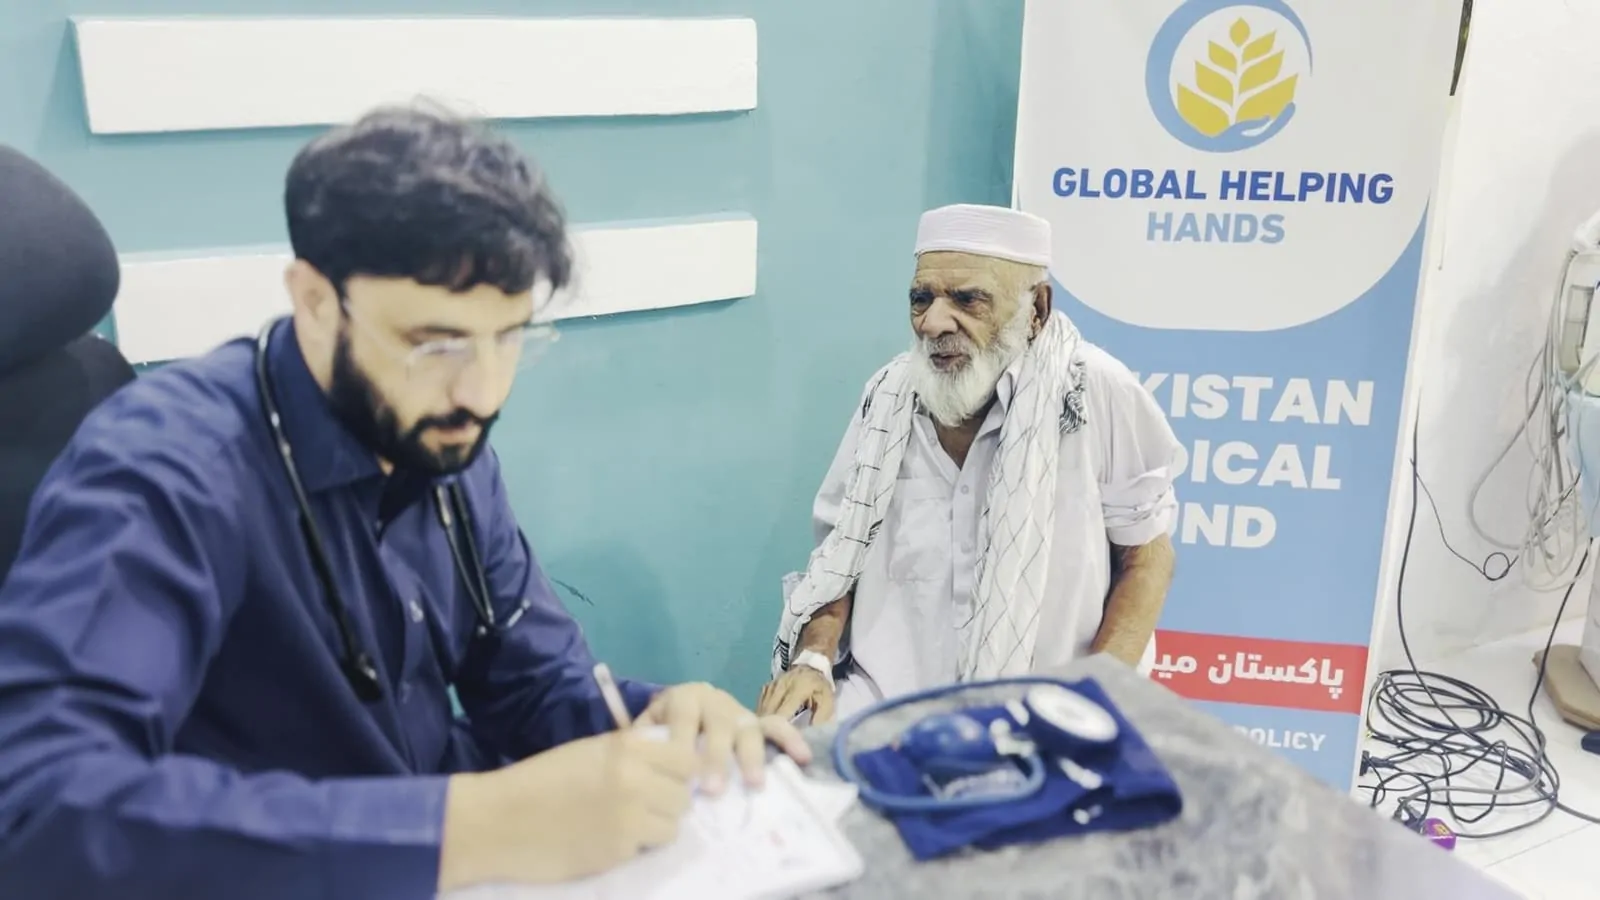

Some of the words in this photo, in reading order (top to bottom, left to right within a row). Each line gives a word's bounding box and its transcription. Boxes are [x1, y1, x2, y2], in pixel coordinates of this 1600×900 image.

[1052, 168, 1207, 200] GLOBAL
[1219, 170, 1394, 204] HELPING
[1146, 211, 1285, 244] HANDS
[1172, 502, 1277, 548] ND
[1207, 652, 1344, 699] پاکستان
